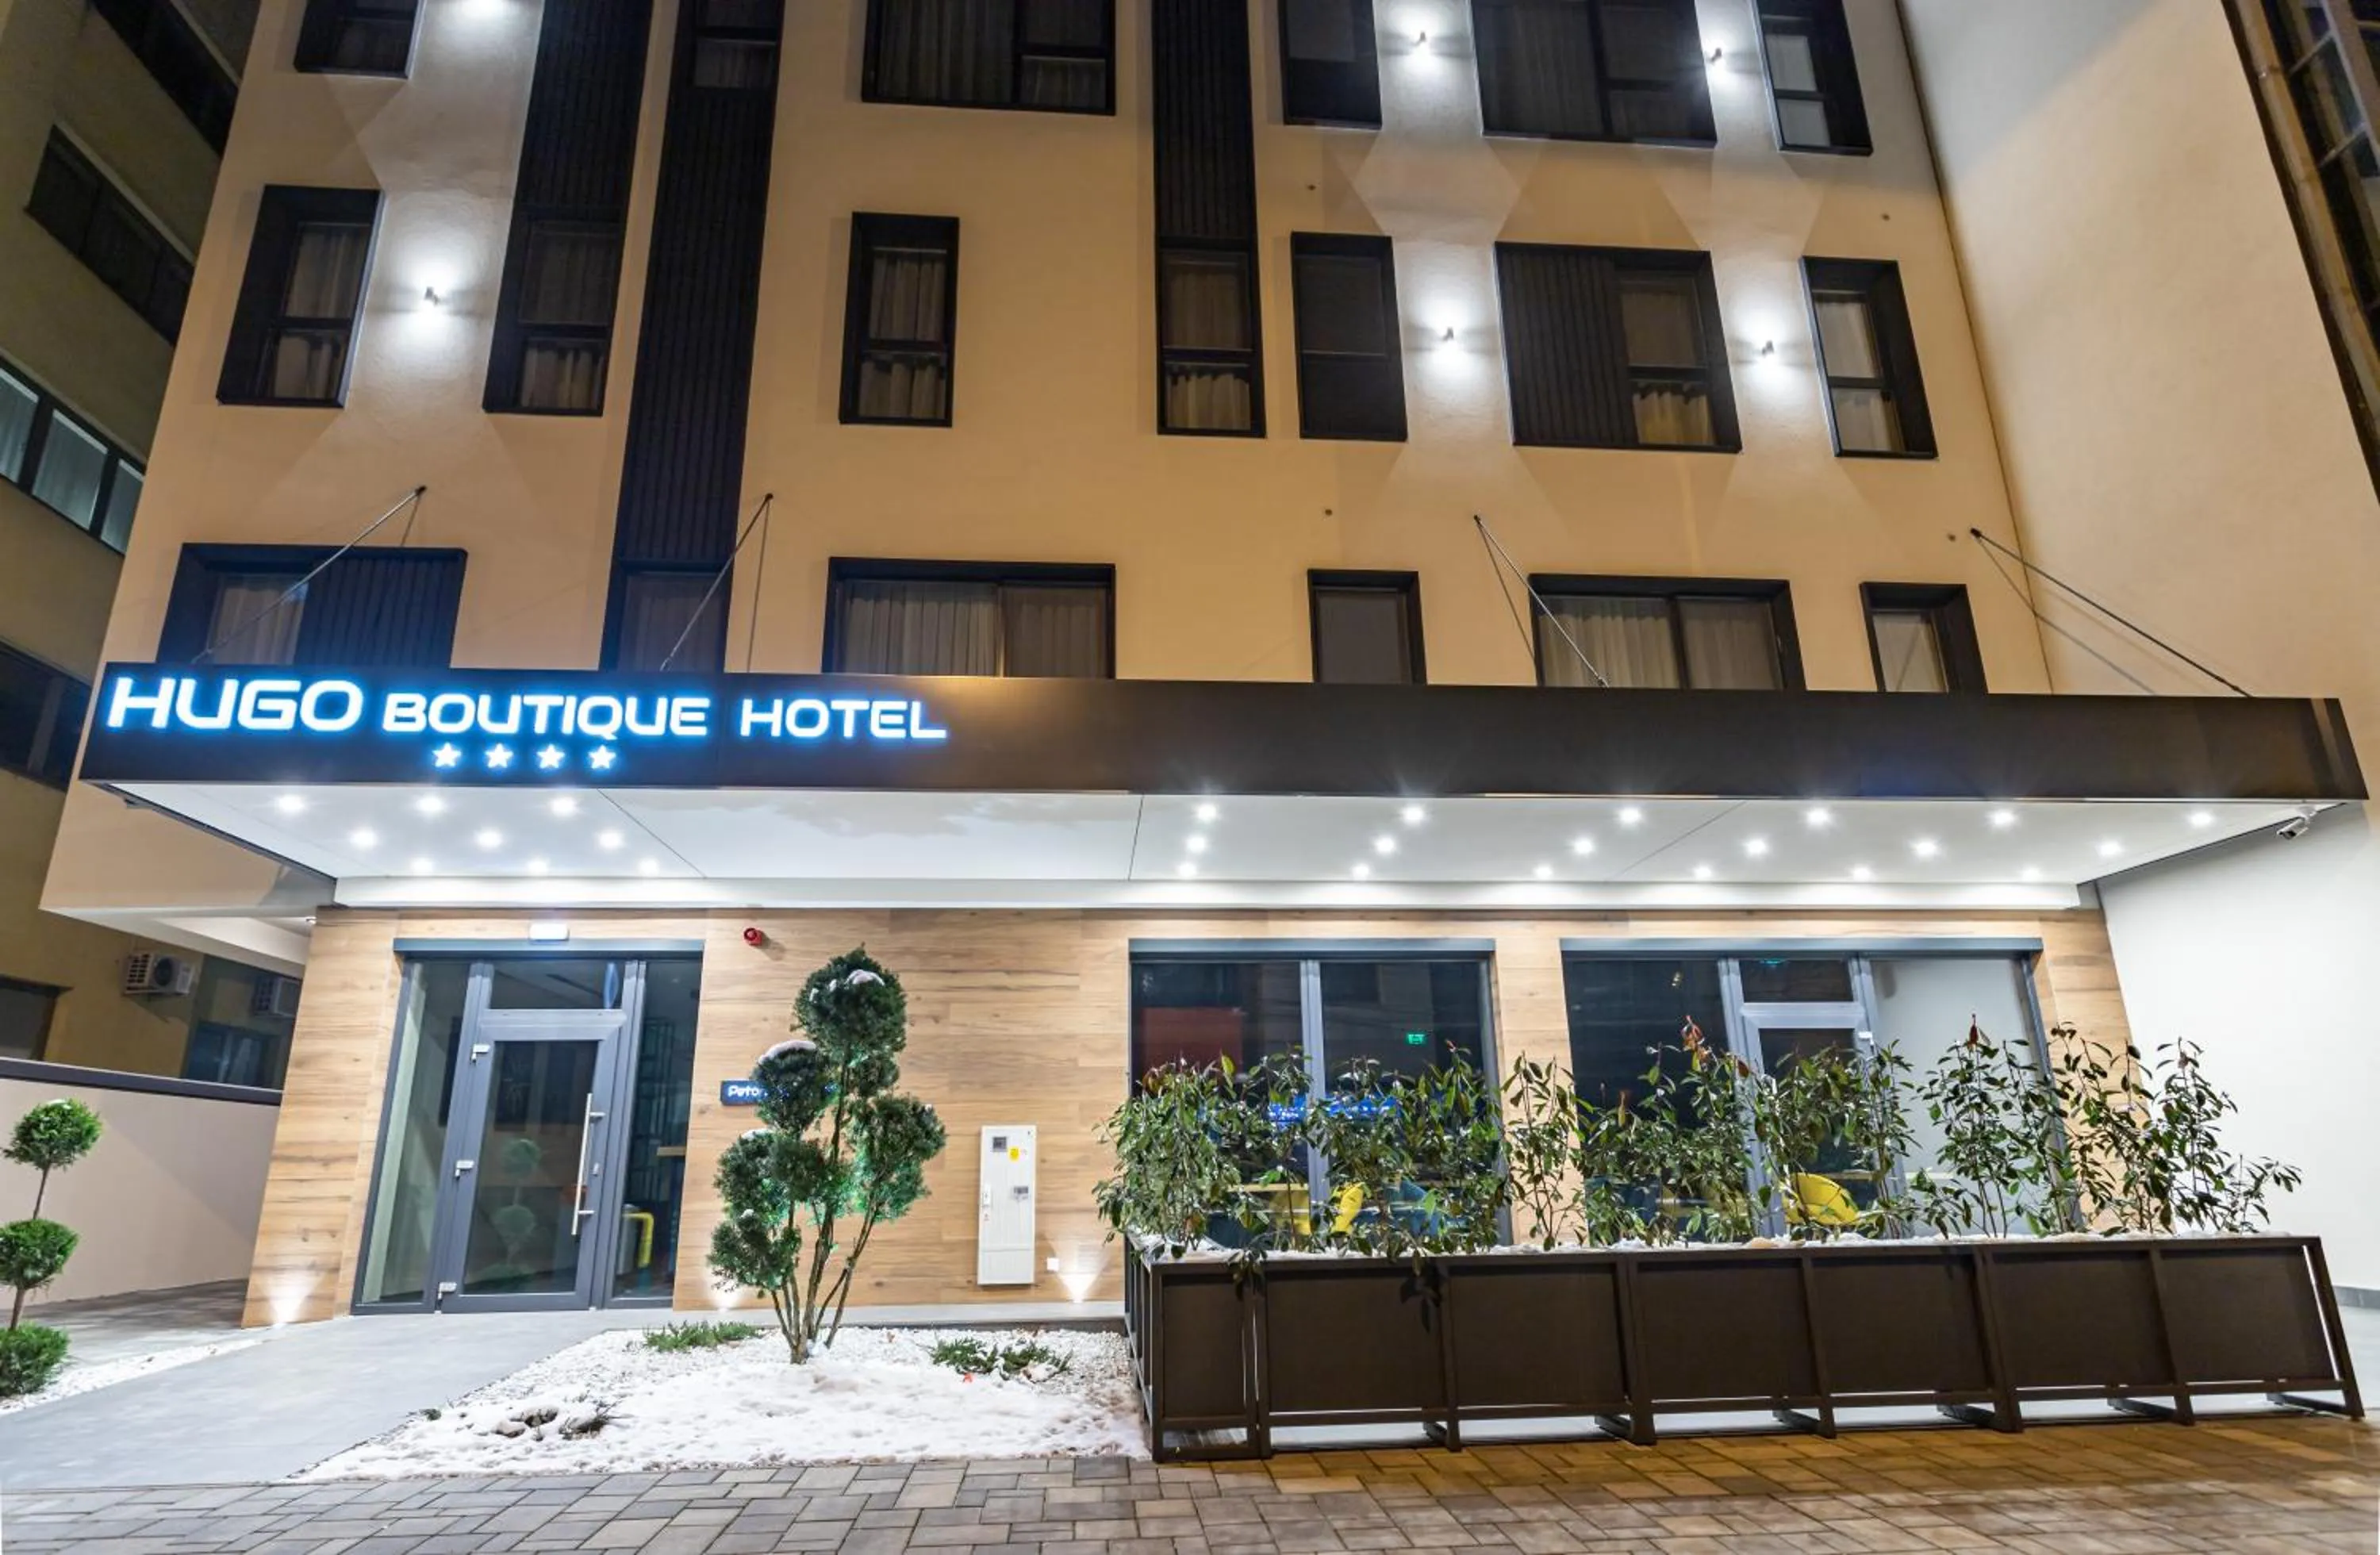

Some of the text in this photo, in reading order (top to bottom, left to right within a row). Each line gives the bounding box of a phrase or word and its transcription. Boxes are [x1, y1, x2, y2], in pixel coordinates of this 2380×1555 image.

[107, 678, 946, 739] HUGO BOUTIQUE HOTEL
